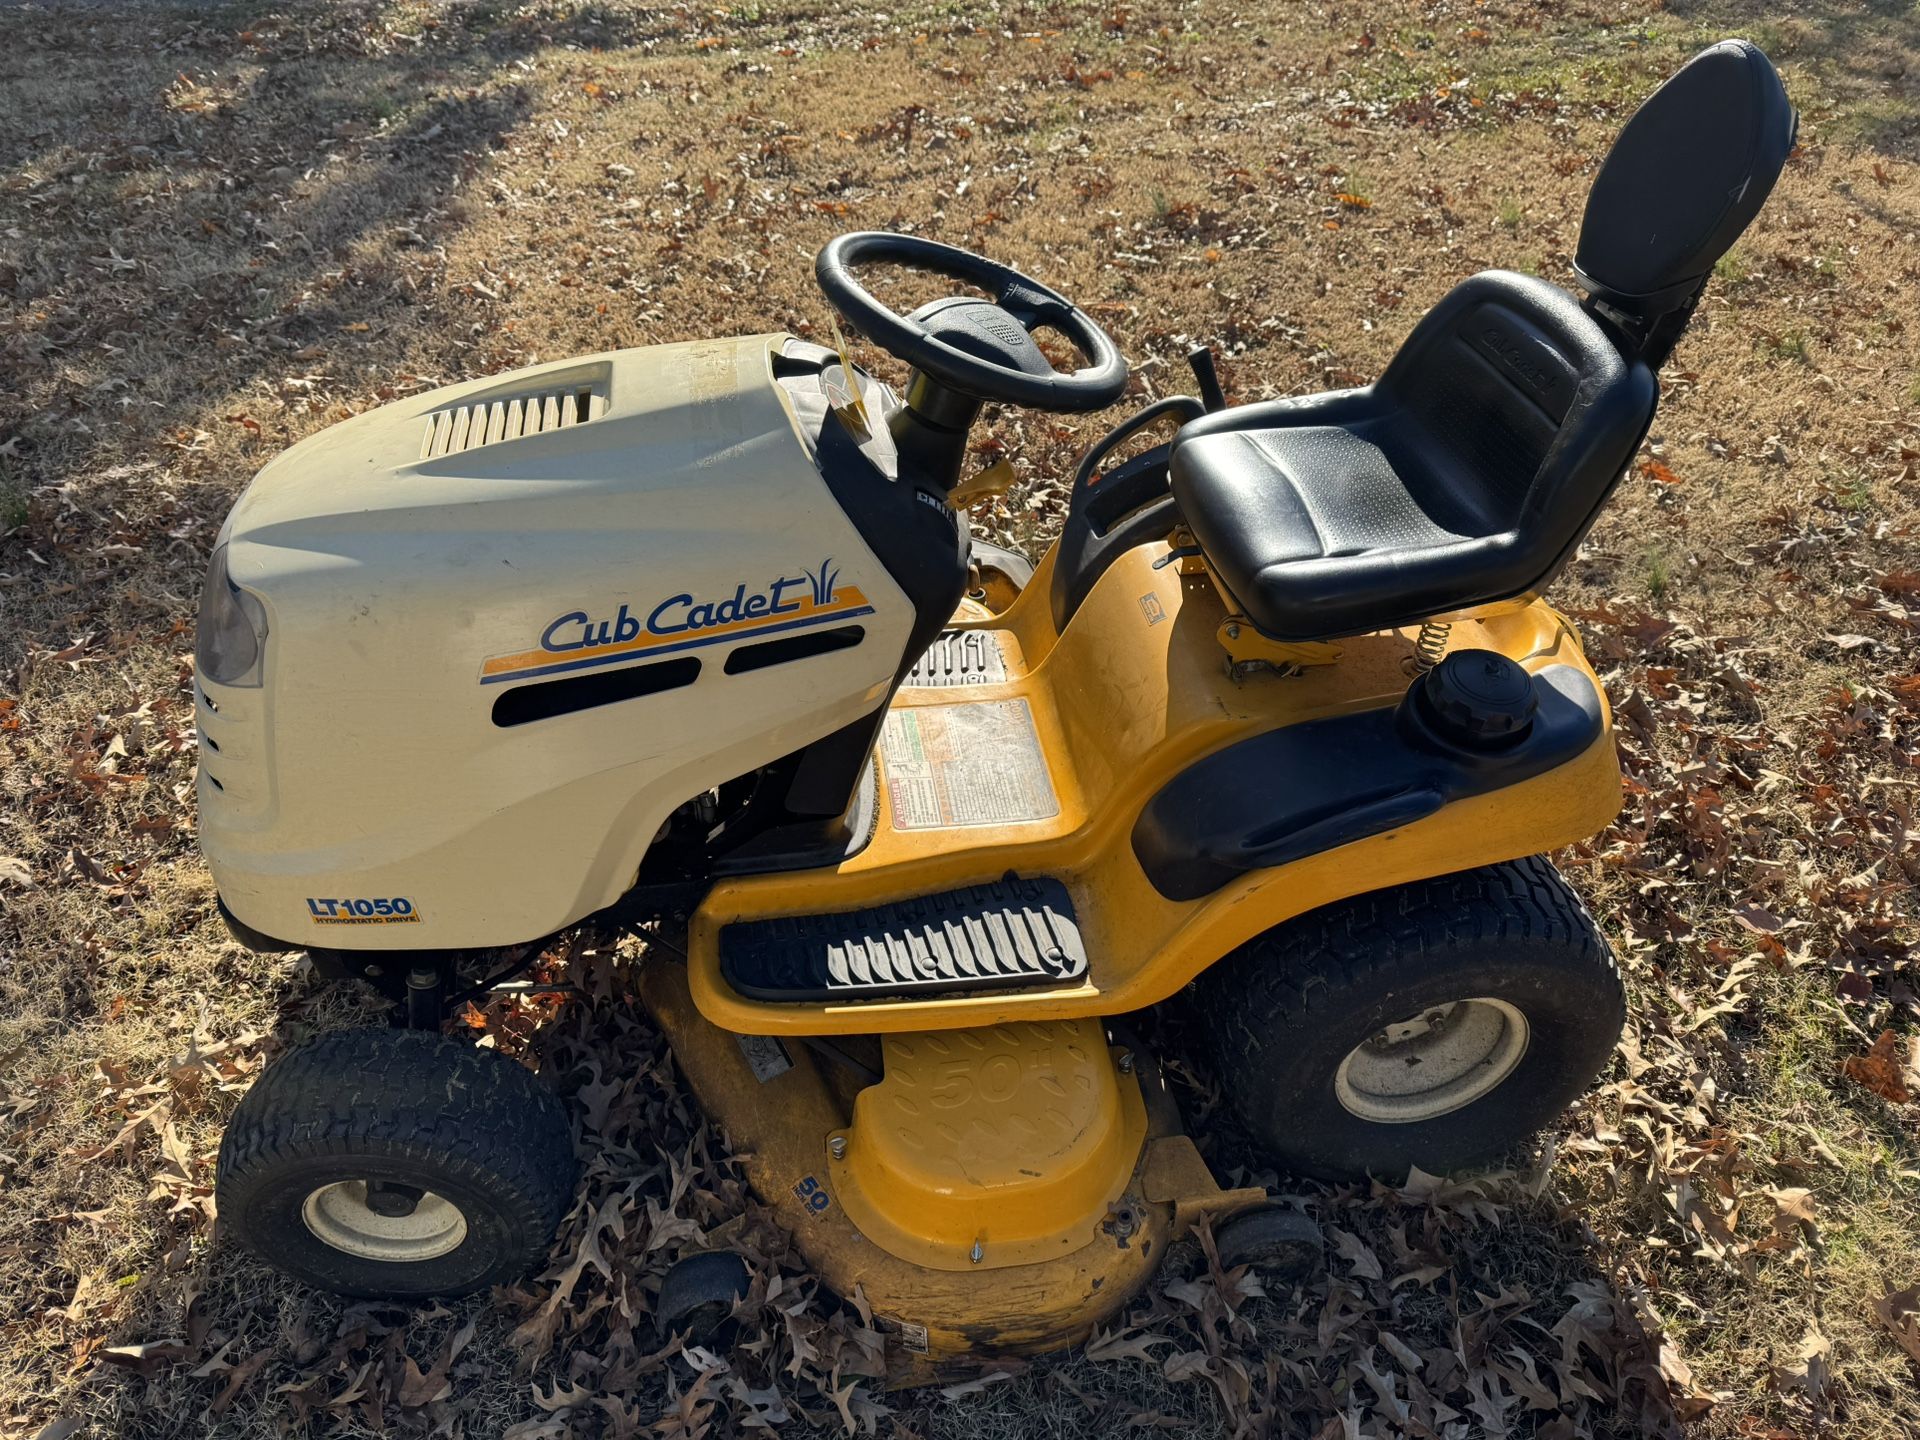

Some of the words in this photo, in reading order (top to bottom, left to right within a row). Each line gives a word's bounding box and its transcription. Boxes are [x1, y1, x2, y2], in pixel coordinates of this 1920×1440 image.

[541, 605, 640, 652] Cub
[646, 577, 806, 635] Cadet
[892, 783, 904, 815] DANGER
[315, 917, 383, 925] HYDROSTATIC
[385, 915, 418, 924] DRIVE
[799, 1176, 830, 1210] 50
[804, 1202, 818, 1217] CUT
